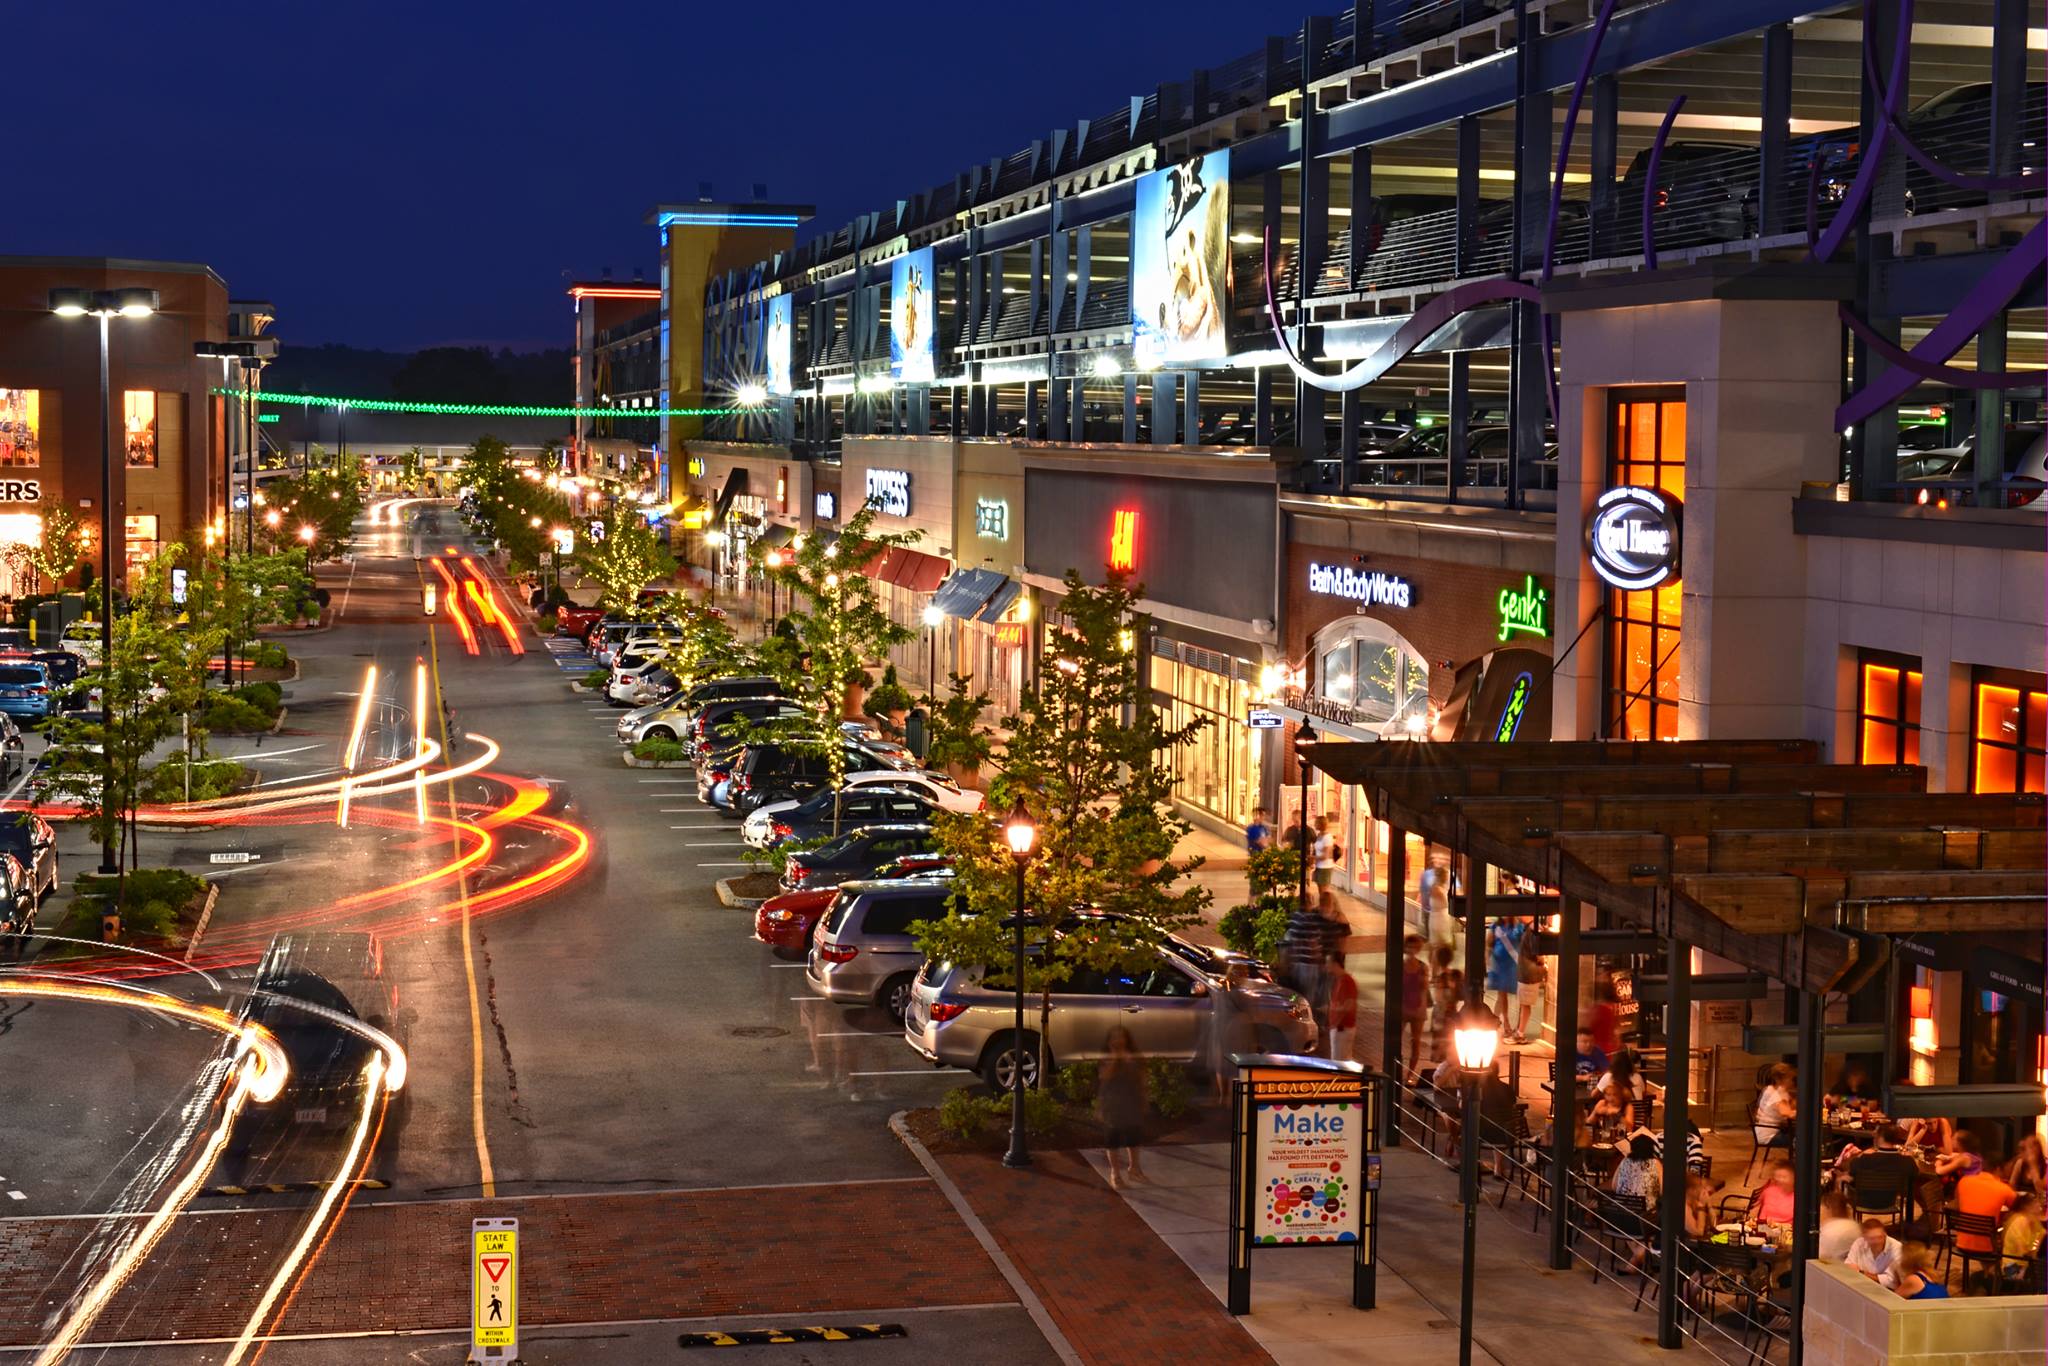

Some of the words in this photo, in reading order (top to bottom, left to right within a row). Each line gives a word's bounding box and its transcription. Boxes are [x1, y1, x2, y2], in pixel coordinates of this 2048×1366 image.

[1309, 562, 1335, 594] Bath
[1335, 567, 1343, 597] &
[1343, 567, 1373, 607] Body
[1372, 572, 1409, 608] Works
[1258, 1082, 1319, 1098] LEGACY
[1313, 1076, 1369, 1098] place
[1274, 1111, 1344, 1134] Make
[1294, 1176, 1321, 1184] CREATE
[483, 1234, 509, 1242] STATE
